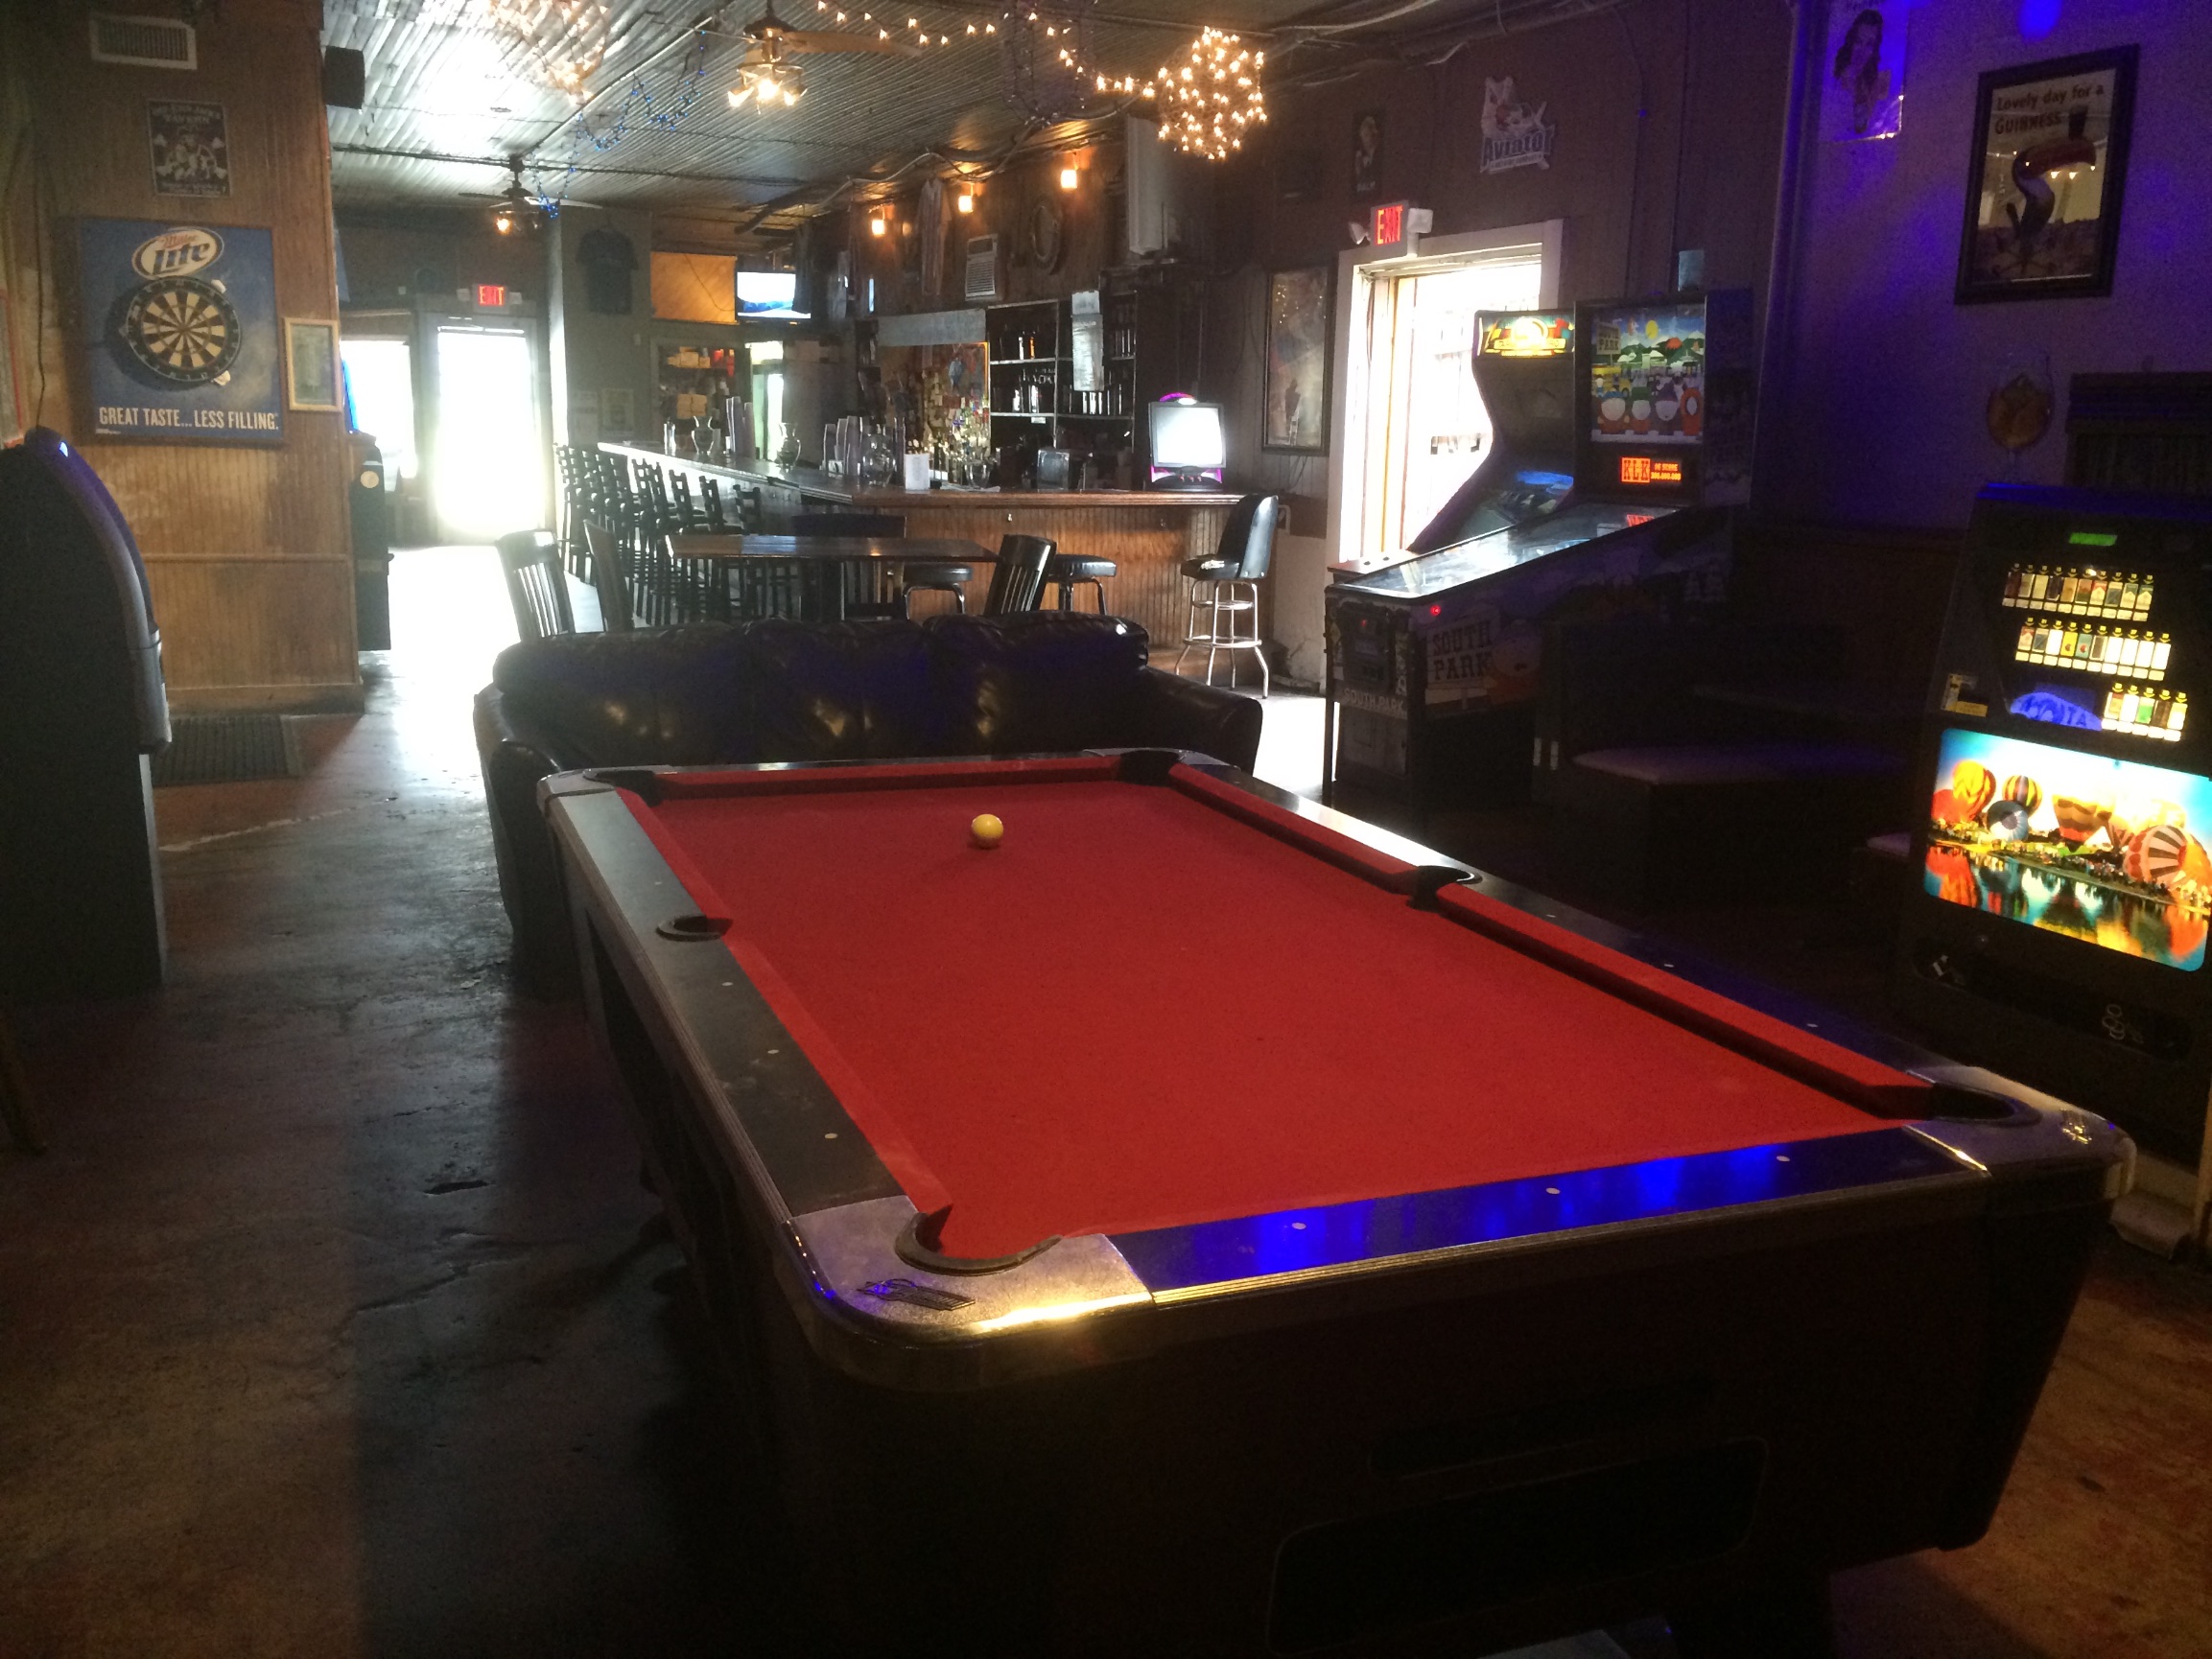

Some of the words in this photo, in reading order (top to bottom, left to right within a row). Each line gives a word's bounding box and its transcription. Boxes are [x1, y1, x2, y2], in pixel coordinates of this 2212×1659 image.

[1996, 93, 2038, 111] Lovely
[2042, 88, 2067, 105] day
[2072, 84, 2092, 99] for
[2095, 84, 2104, 95] a
[1377, 205, 1402, 245] EXIT
[479, 286, 504, 305] EXIT
[1598, 339, 1619, 351] PARK
[99, 407, 139, 426] GREAT
[143, 408, 193, 428] TASTE...
[194, 409, 224, 429] LESS
[228, 411, 279, 431] FILLING.
[1624, 460, 1649, 481] KLK
[1433, 620, 1494, 656] SOUTH
[1433, 652, 1494, 680] PARK
[1344, 688, 1377, 712] SOUTH
[1378, 696, 1404, 713] PARK
